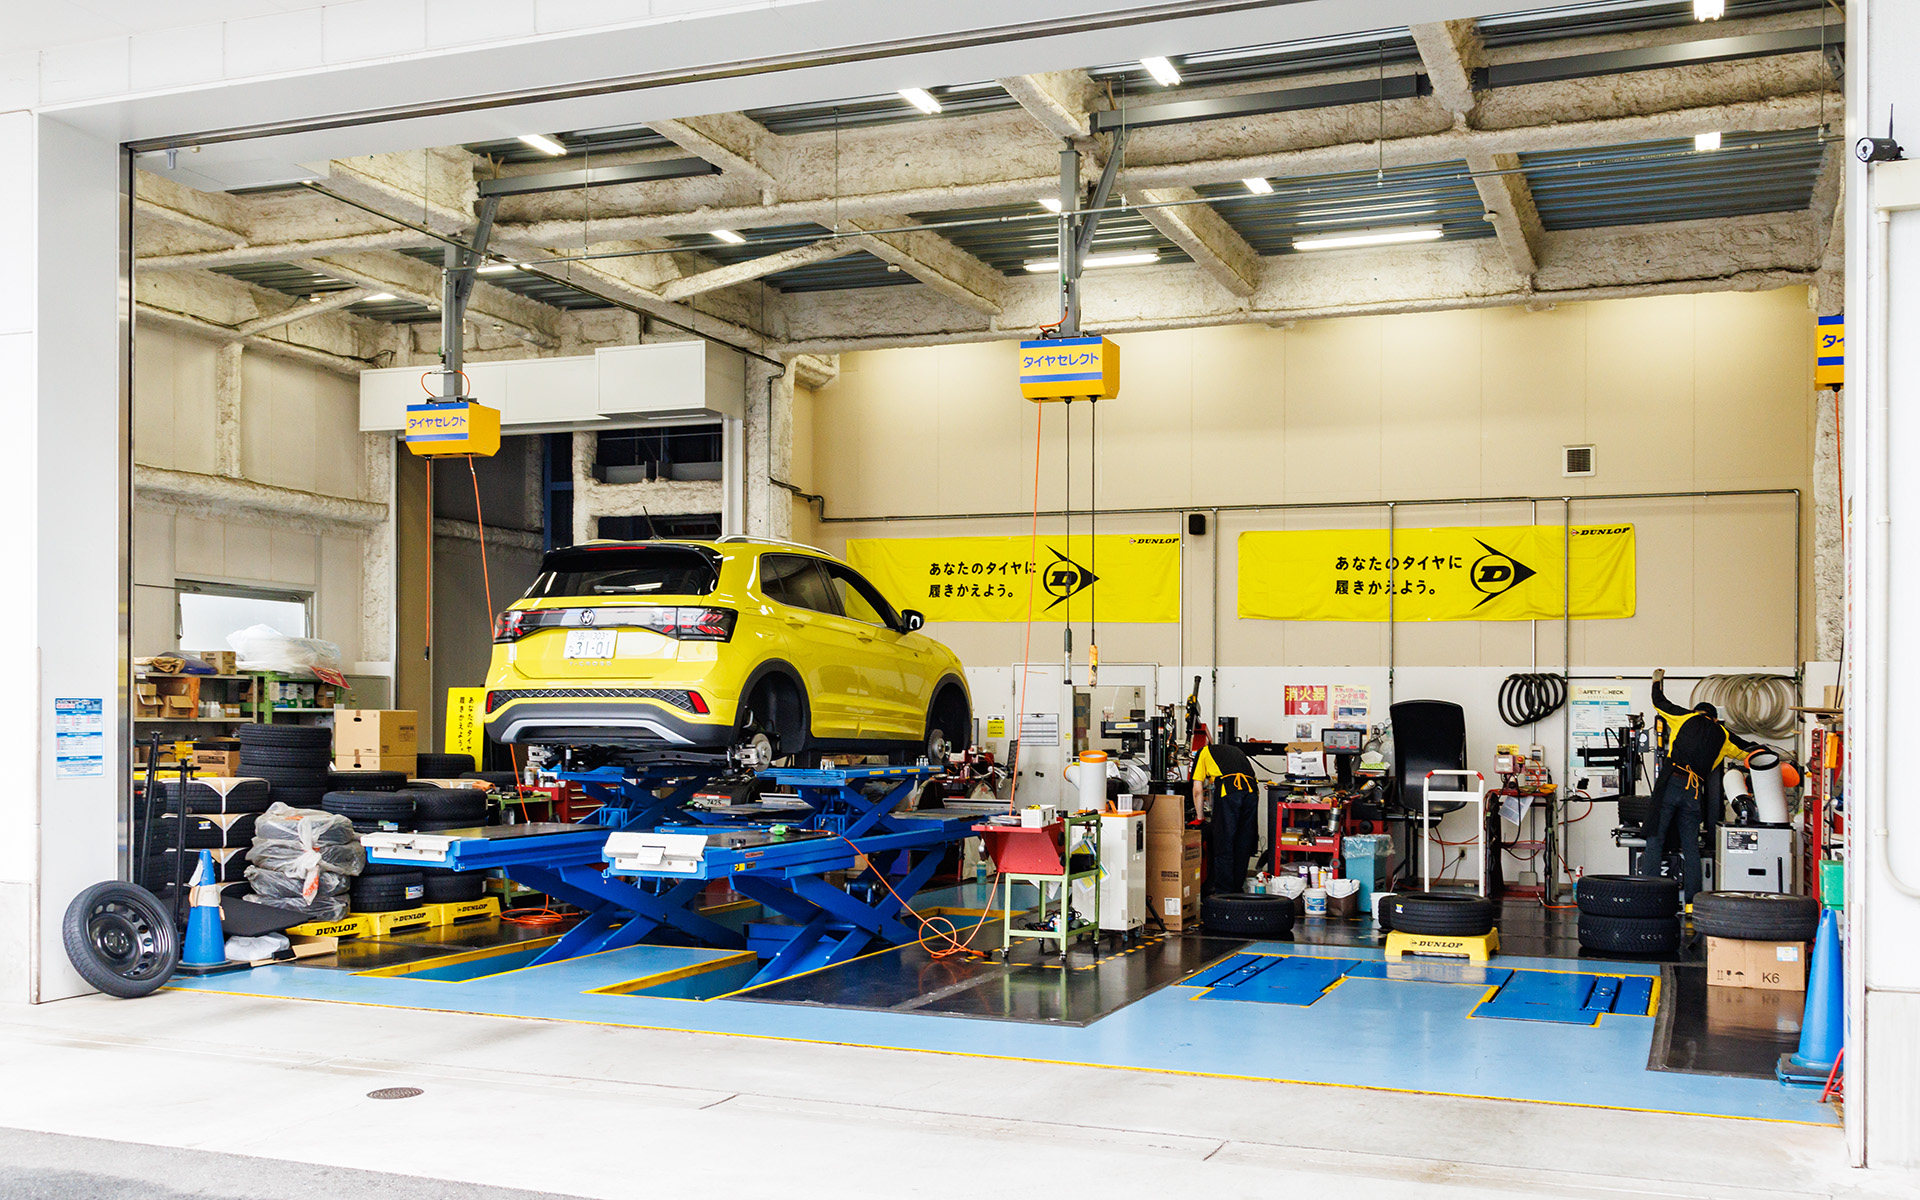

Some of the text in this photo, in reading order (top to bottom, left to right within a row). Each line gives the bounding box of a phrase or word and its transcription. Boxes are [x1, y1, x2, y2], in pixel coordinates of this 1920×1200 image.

[1023, 352, 1099, 368] タイヤセレクト
[408, 415, 467, 429] タイヤセレクト
[1580, 526, 1631, 536] DUNLOP
[1137, 537, 1180, 545] DUNLOP
[929, 560, 1037, 576] あなたのタイヤに
[1335, 554, 1463, 571] あなたのタイヤに
[928, 583, 1014, 598] 履きかえよう。
[1334, 579, 1436, 596] 履きかえよう。
[1285, 687, 1325, 702] 消火器
[1577, 687, 1625, 696] SAFETY CHECK
[462, 903, 488, 912] DUNLOP
[398, 912, 427, 922] DUNLOP
[316, 922, 358, 936] DUNLOP
[1418, 940, 1464, 949] DUNLOP
[1761, 972, 1781, 984] K6
